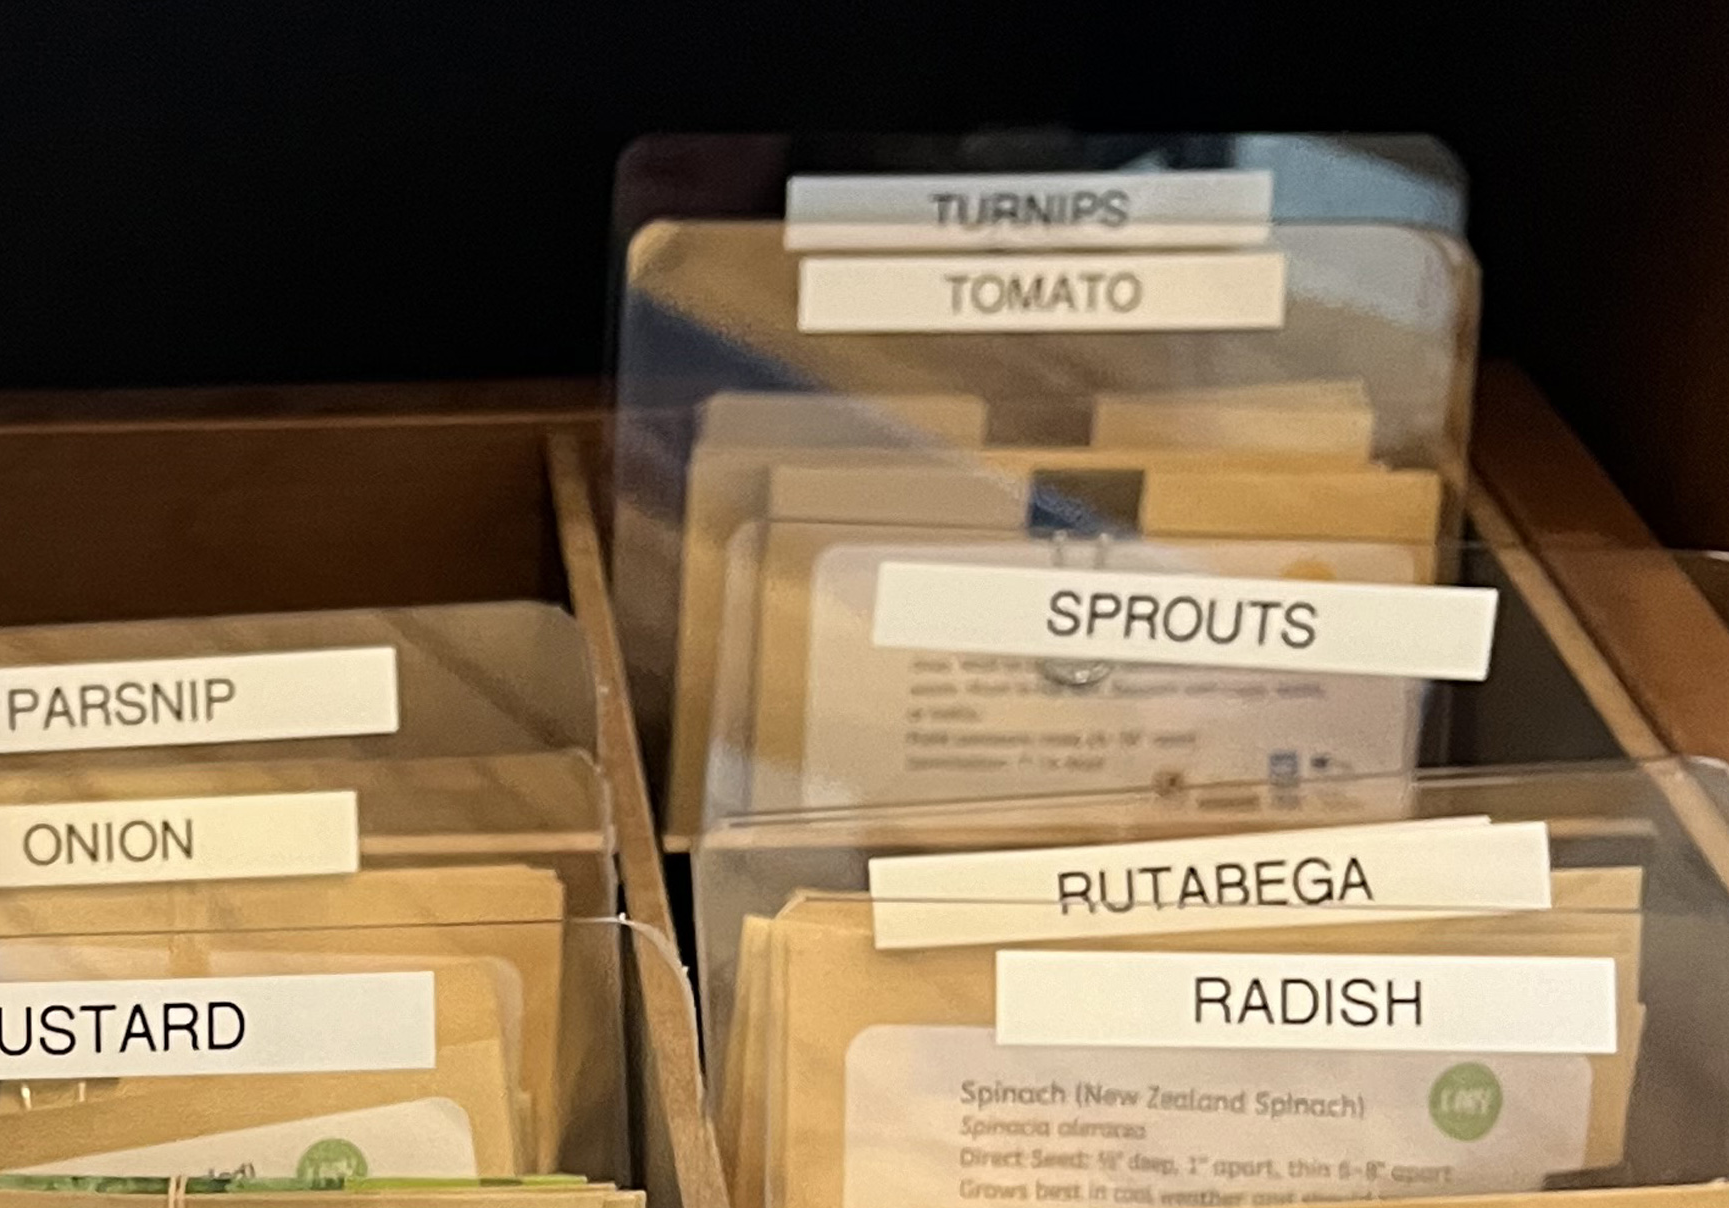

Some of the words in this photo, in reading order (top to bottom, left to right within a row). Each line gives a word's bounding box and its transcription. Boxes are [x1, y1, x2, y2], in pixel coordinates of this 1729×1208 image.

[930, 190, 1130, 228] TURNIPS
[943, 271, 1143, 315] TOMATO
[1046, 589, 1319, 650] SPROUTS
[7, 678, 236, 731] PARSNIP
[22, 818, 194, 867] ONION
[1057, 856, 1374, 916] RUTABEGA
[1195, 976, 1423, 1027] RADISH
[960, 1080, 1066, 1111] Spinach
[1076, 1081, 1139, 1107] (New
[1147, 1084, 1245, 1113] Zealand
[1255, 1090, 1365, 1120] Spinach)
